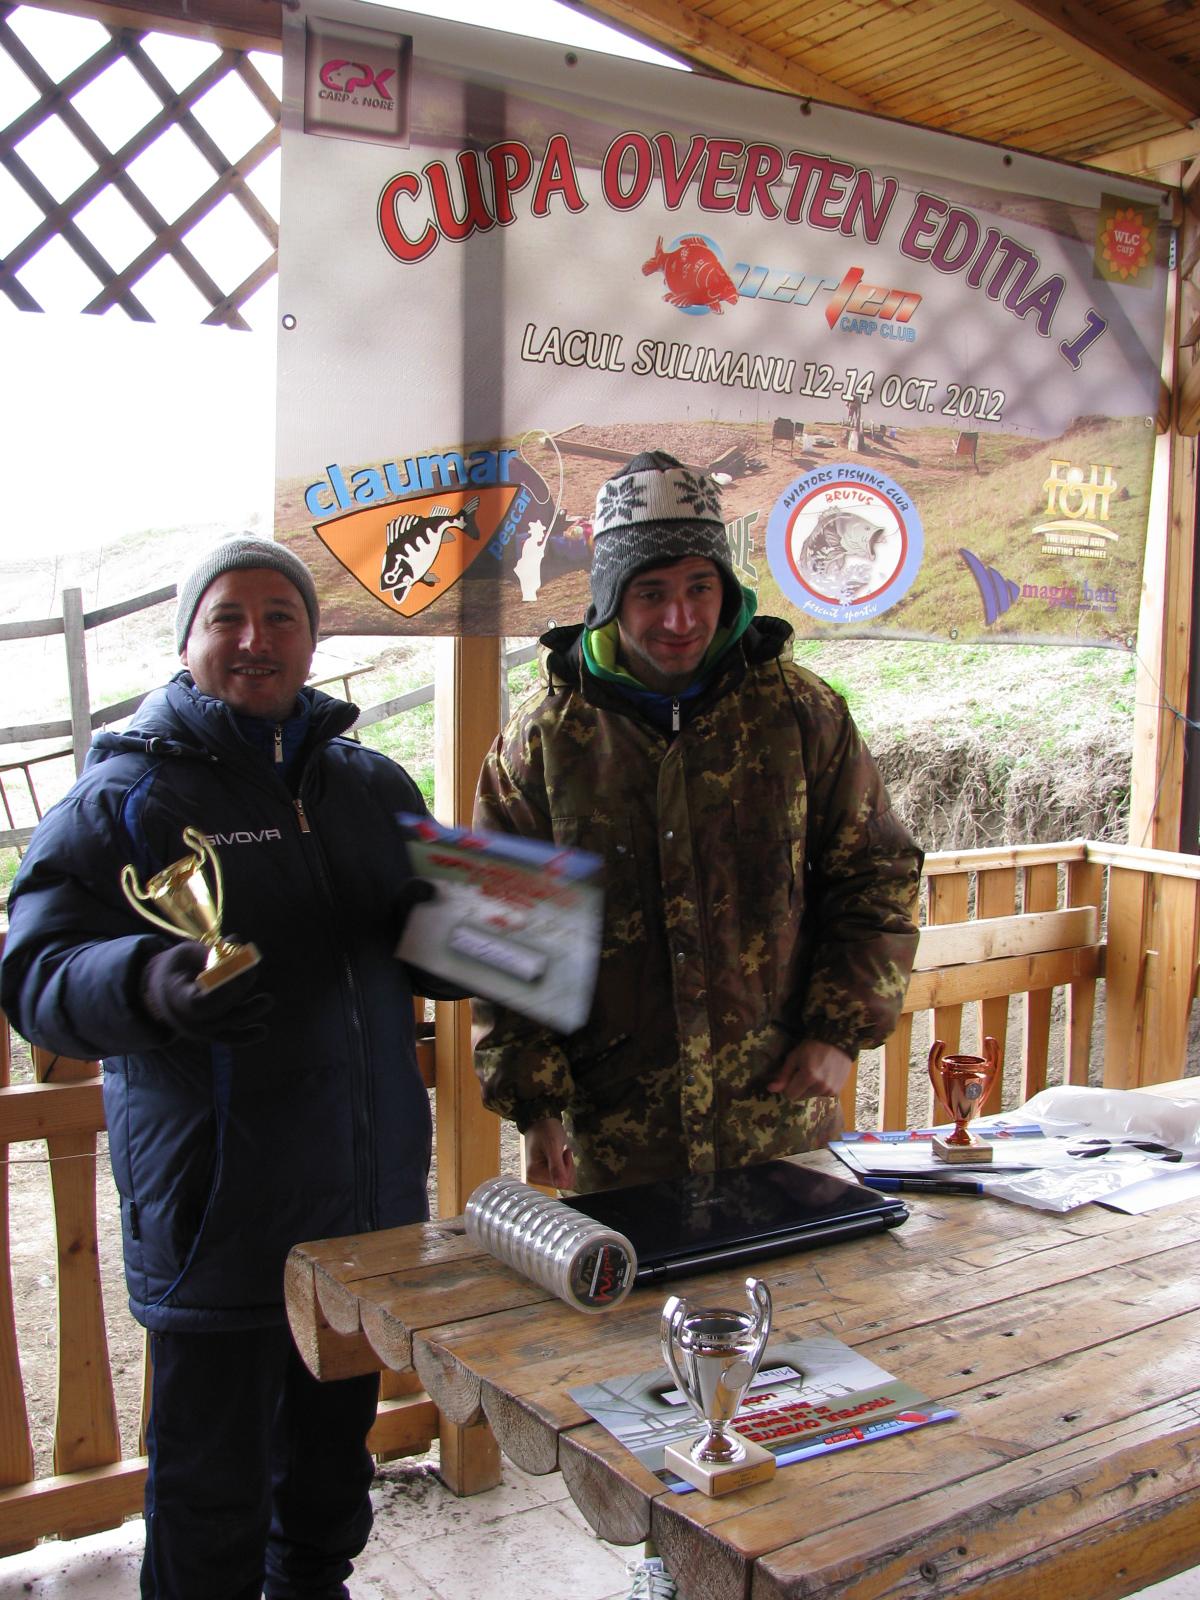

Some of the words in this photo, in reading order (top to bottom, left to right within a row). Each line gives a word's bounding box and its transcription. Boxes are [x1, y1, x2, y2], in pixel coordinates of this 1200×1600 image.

[318, 89, 350, 103] CARP
[1114, 230, 1140, 246] WLC
[377, 133, 589, 264] CUPA
[601, 131, 899, 244] OVERTEN
[1059, 308, 1107, 371] 1
[840, 317, 877, 335] CARP
[880, 323, 916, 343] CLUB
[521, 323, 625, 372] LACUL
[632, 339, 796, 394] SULIMANU
[800, 362, 875, 404] 12-14
[880, 374, 937, 413] OCT.
[941, 383, 1006, 422] 2012
[304, 449, 518, 518] claumar
[783, 470, 833, 509] AVIATORS
[837, 469, 885, 490] FISHING
[886, 488, 909, 513] CLUB
[825, 490, 874, 506] BRUTUS
[1074, 547, 1107, 558] CHANNEL
[744, 1420, 821, 1442] OVERTE
